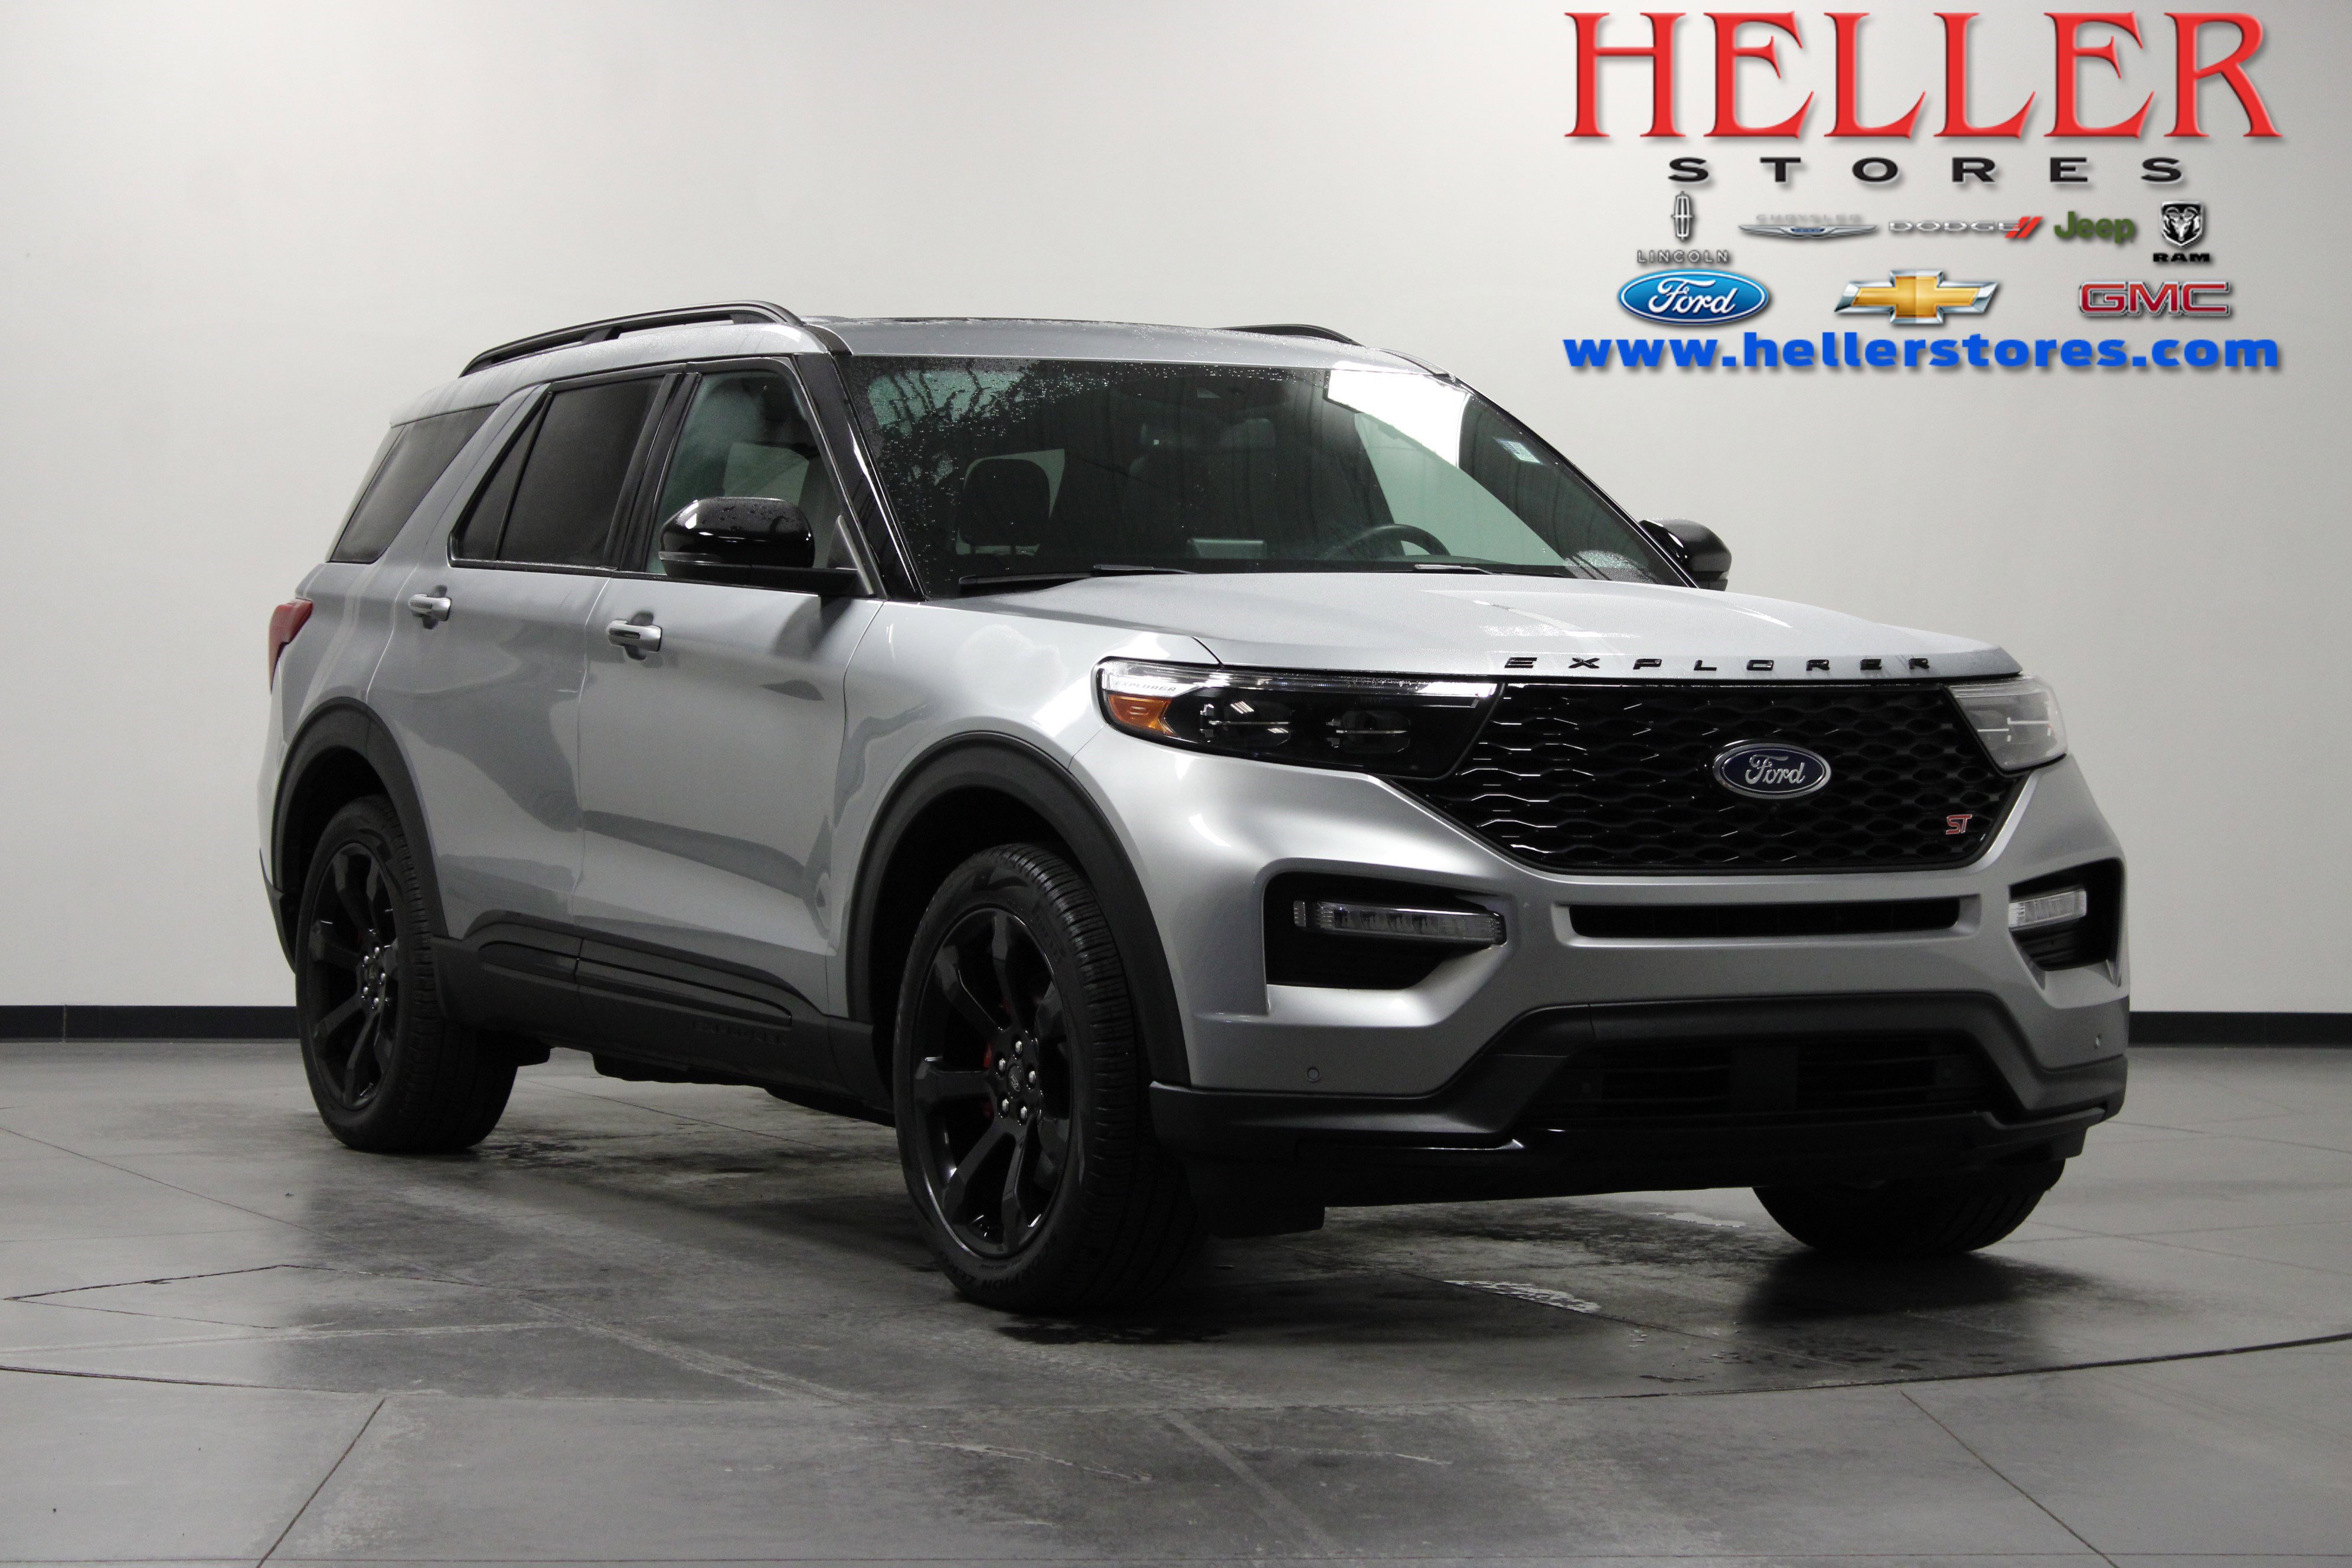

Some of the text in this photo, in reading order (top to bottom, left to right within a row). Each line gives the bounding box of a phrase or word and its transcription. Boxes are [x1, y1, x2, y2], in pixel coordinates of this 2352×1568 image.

[1504, 657, 1930, 672] EXPLORER
[1745, 754, 1805, 784] Ford
[1946, 814, 1972, 834] ST
